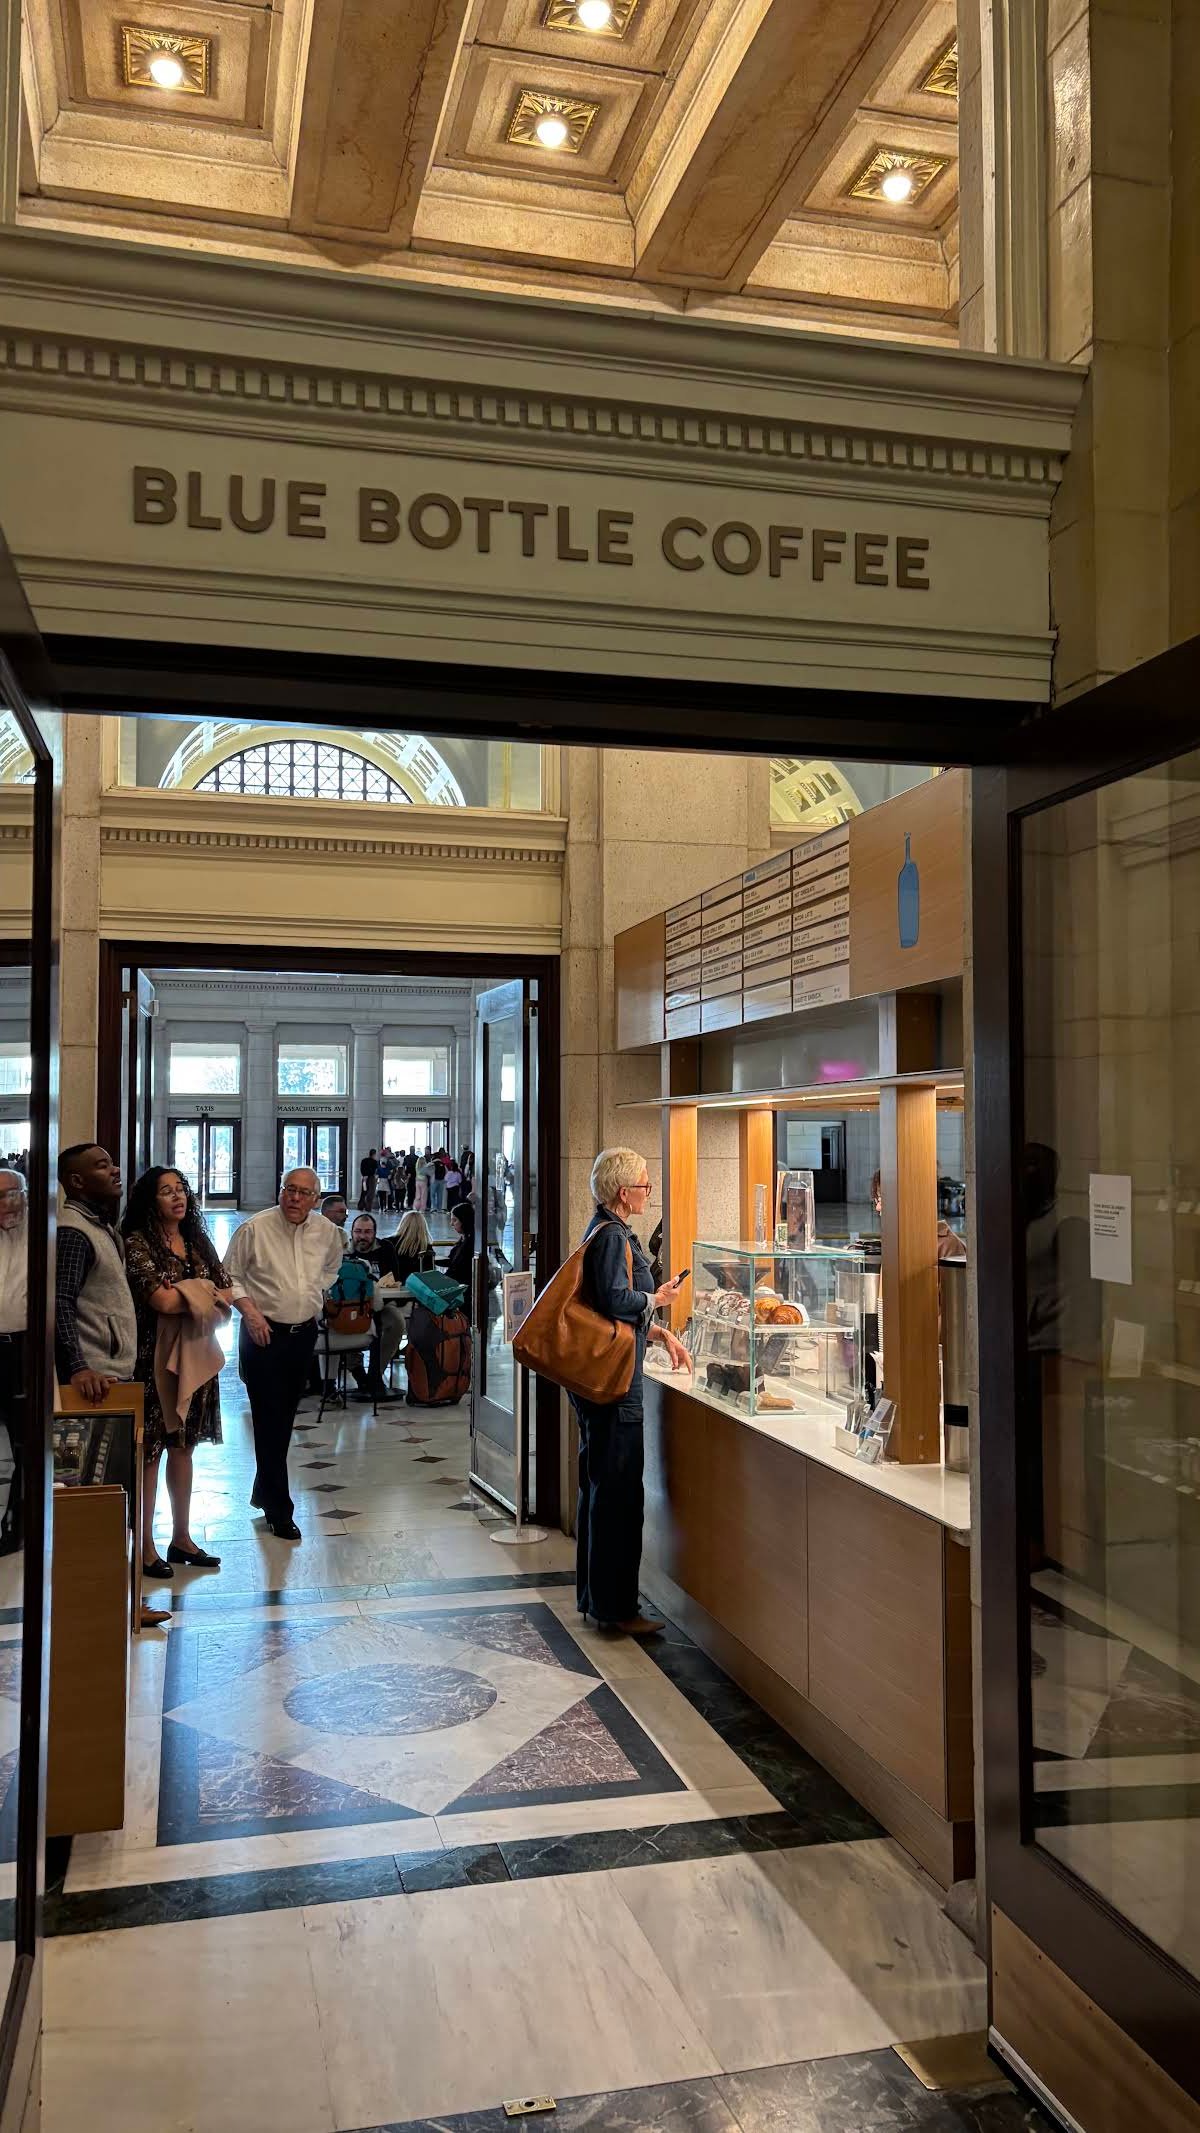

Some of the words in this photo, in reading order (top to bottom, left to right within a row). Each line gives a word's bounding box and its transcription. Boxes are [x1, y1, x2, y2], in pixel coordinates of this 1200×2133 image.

[133, 466, 327, 539] BLUE
[359, 487, 633, 566] BOTTLE
[661, 516, 930, 591] COFFEE
